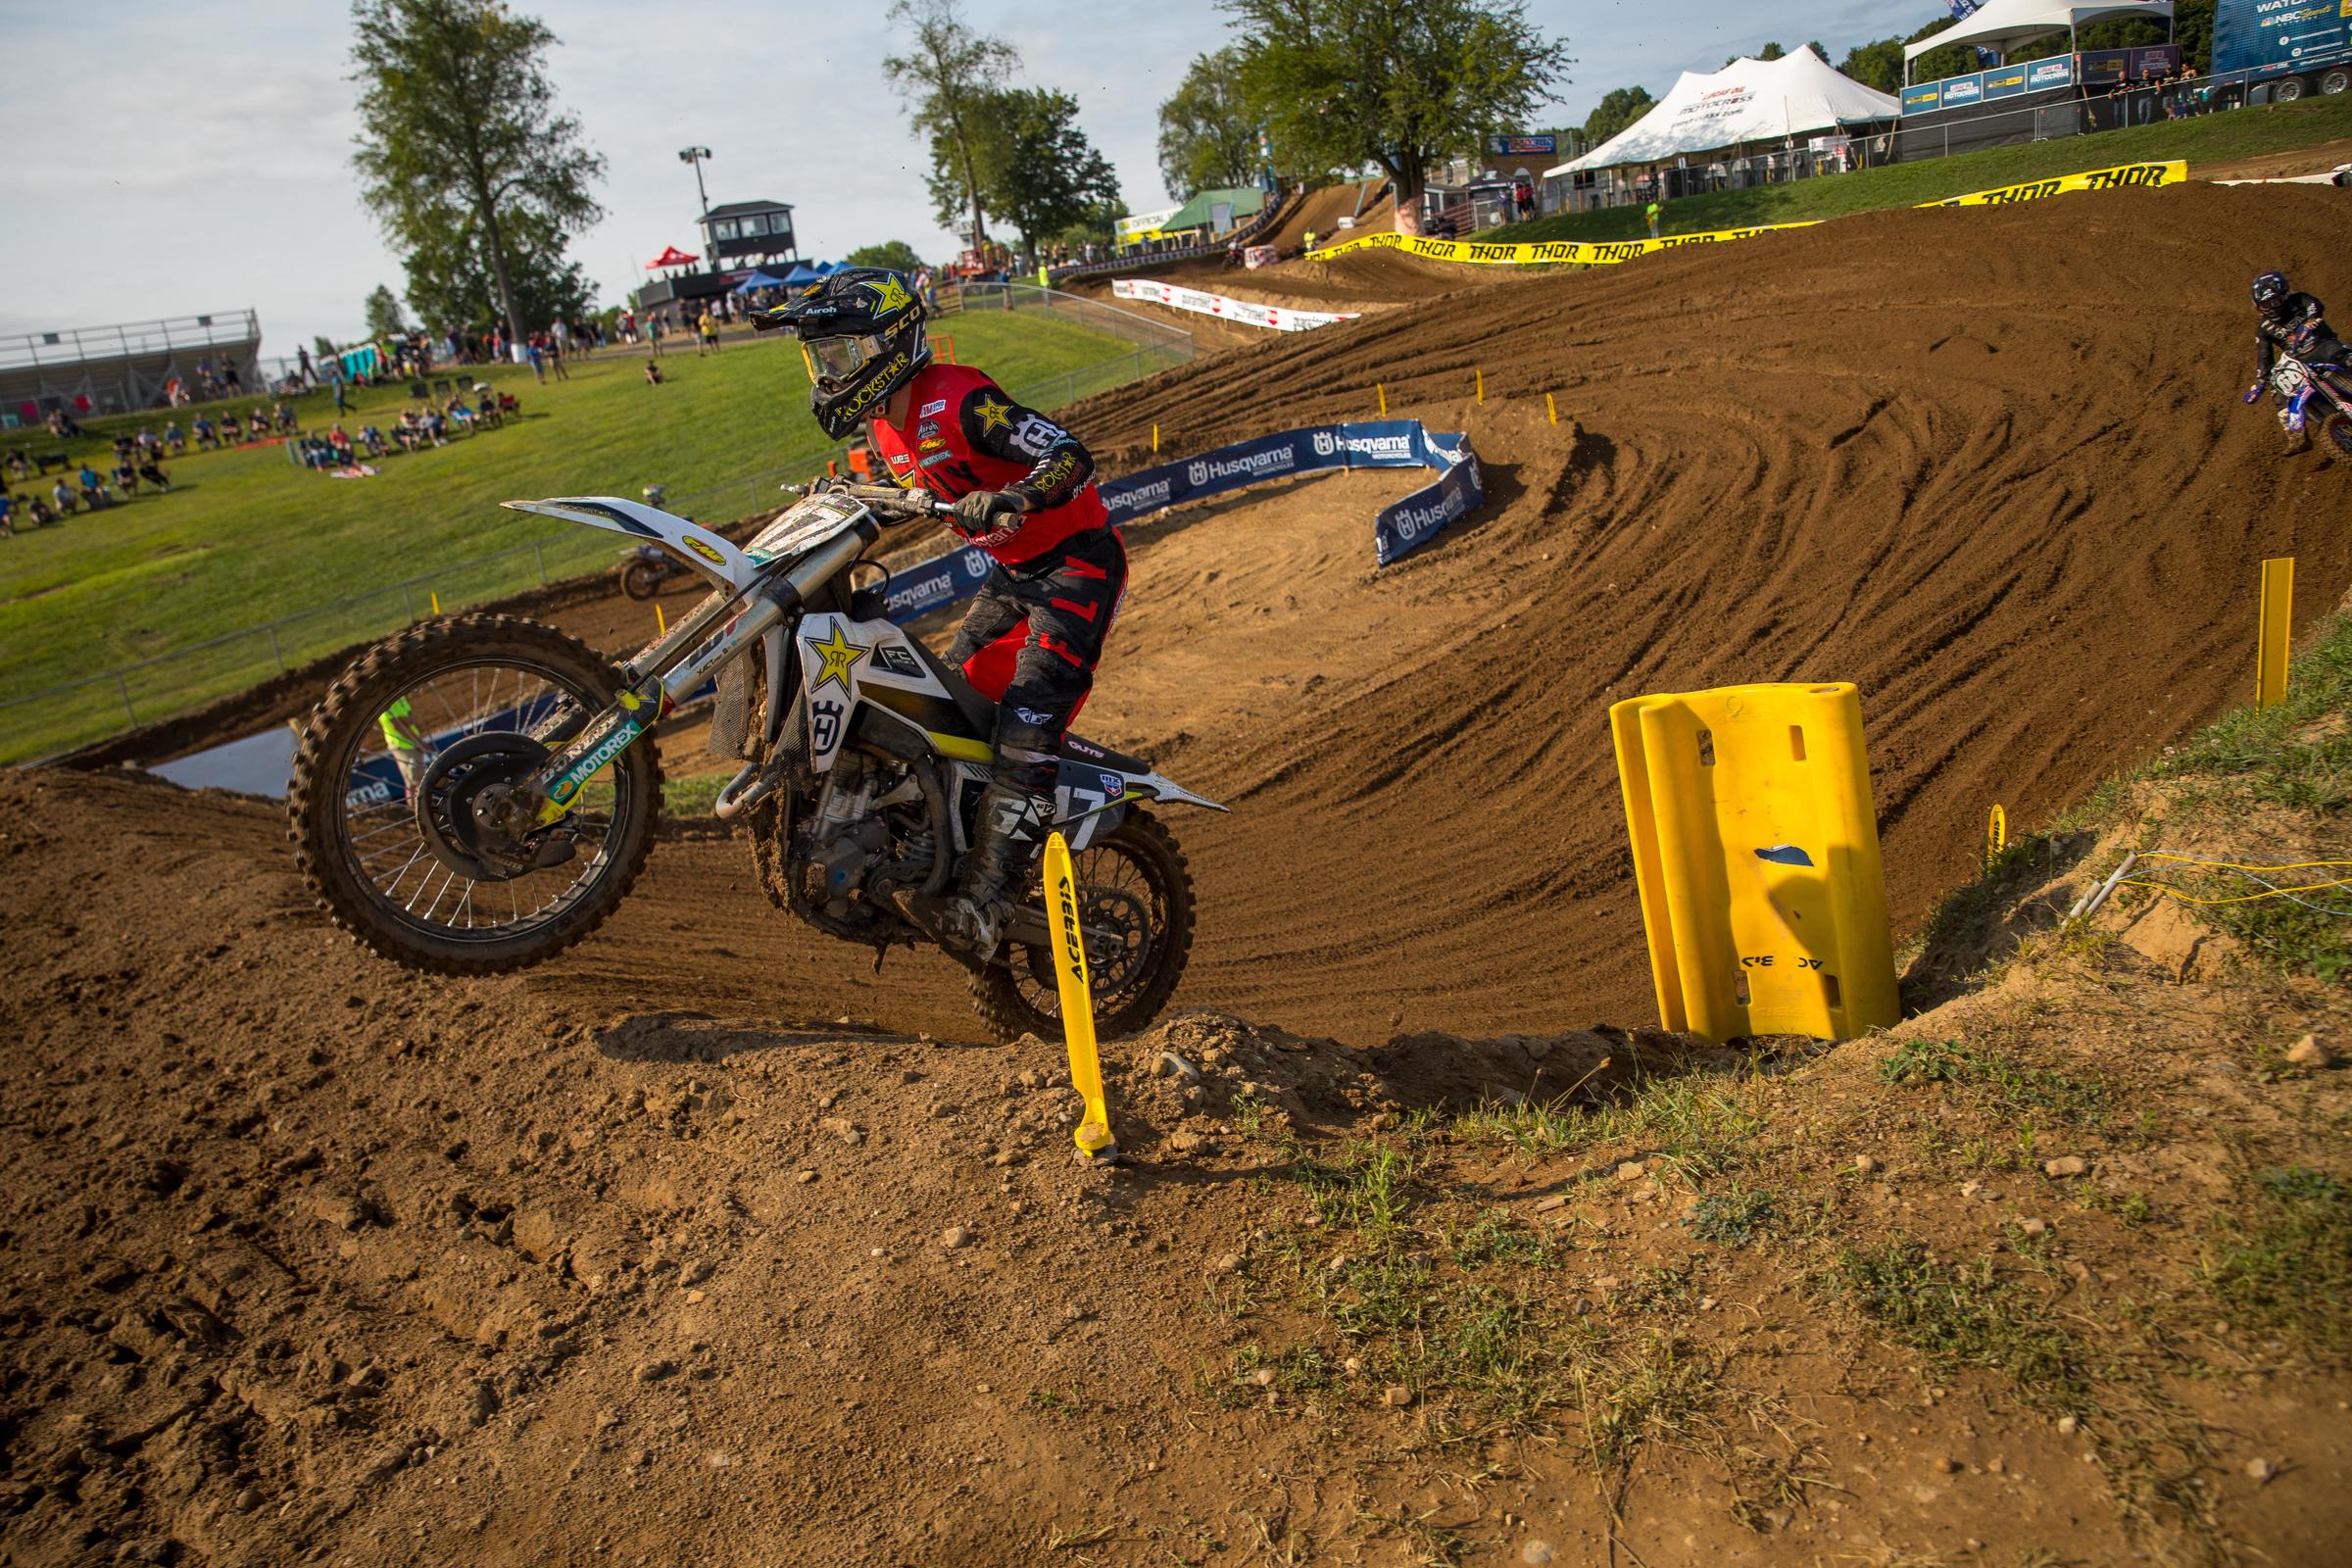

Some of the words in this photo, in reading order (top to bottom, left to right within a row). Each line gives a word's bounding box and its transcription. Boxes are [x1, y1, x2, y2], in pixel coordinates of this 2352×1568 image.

[2275, 11, 2302, 24] NBC
[2086, 166, 2168, 189] THOR
[1370, 234, 1401, 249] THOR
[1413, 238, 1455, 258] THOR
[1469, 244, 1517, 261] THOR
[1531, 244, 1581, 260] THOR
[1592, 243, 1645, 261] THOR
[805, 306, 837, 316] Airoh
[918, 422, 939, 436] Airoh
[1336, 435, 1410, 454] Husqvarna
[1208, 446, 1293, 478] Husqvarna
[569, 724, 638, 785] MOTOREX
[1067, 740, 1105, 759] GUTS
[1058, 875, 1085, 985] ACERBIS
